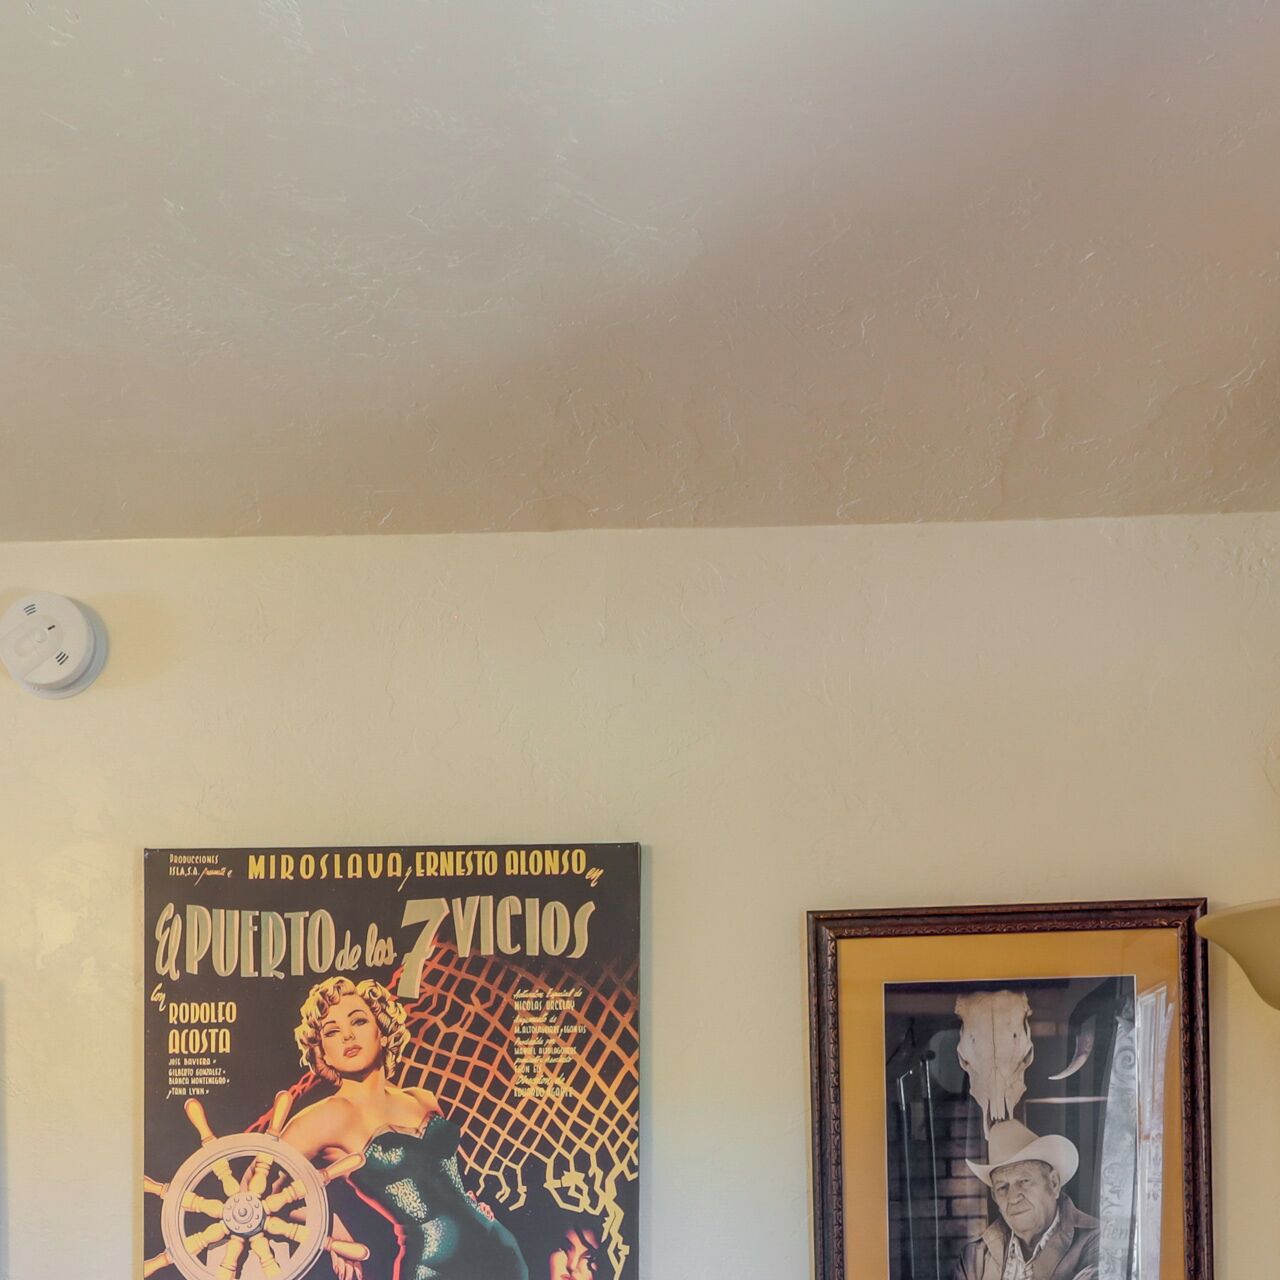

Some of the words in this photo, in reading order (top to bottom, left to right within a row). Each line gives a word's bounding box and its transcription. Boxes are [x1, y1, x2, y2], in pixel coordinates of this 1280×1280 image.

[169, 853, 219, 864] PRODUCCIONES
[248, 852, 402, 880] MIROSLAVA
[415, 851, 498, 877] ERNESTO
[505, 848, 587, 876] ALONSO
[585, 867, 604, 888] en
[155, 902, 183, 981] El
[186, 903, 336, 980] PUERTO
[335, 929, 362, 971] de
[365, 922, 398, 967] los
[396, 897, 451, 999] 7
[451, 895, 596, 959] VICIOS
[168, 1002, 237, 1025] RODOLFO
[168, 1028, 231, 1054] ACOSTA
